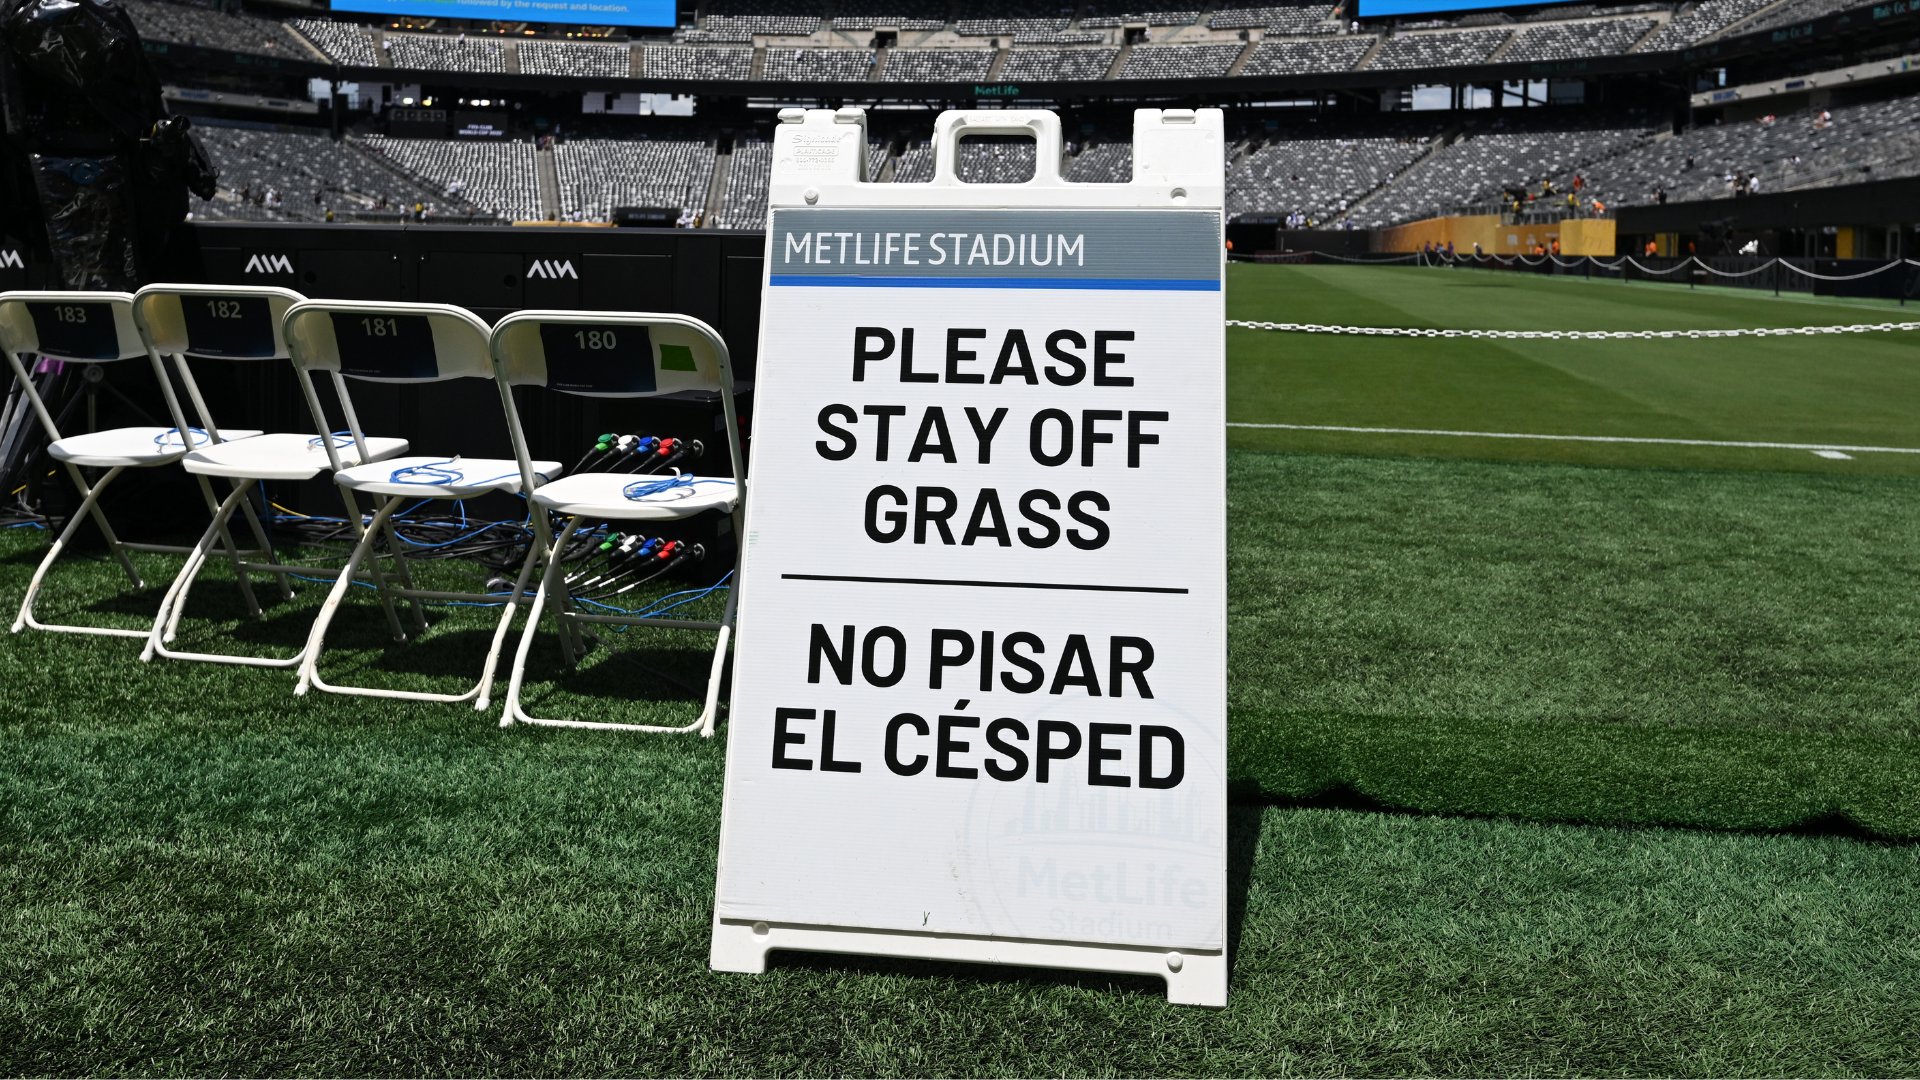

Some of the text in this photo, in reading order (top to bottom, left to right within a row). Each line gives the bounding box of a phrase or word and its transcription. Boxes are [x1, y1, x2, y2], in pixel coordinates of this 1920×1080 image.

[532, 1, 568, 10] request
[975, 85, 1019, 96] MetLife
[784, 232, 1085, 267] METLIFE STADIUM
[54, 306, 87, 323] 183
[207, 301, 242, 318] 182
[361, 318, 398, 336] 181
[574, 330, 617, 349] 180
[853, 326, 1135, 387] PLEASE
[815, 403, 1169, 469] STAY OFF
[864, 484, 1111, 551] GRASS
[807, 623, 1155, 700] NO PISAR
[771, 698, 1185, 790] EL CÉSPED
[1017, 855, 1209, 909] MetLife
[1048, 907, 1174, 940] Stadium
